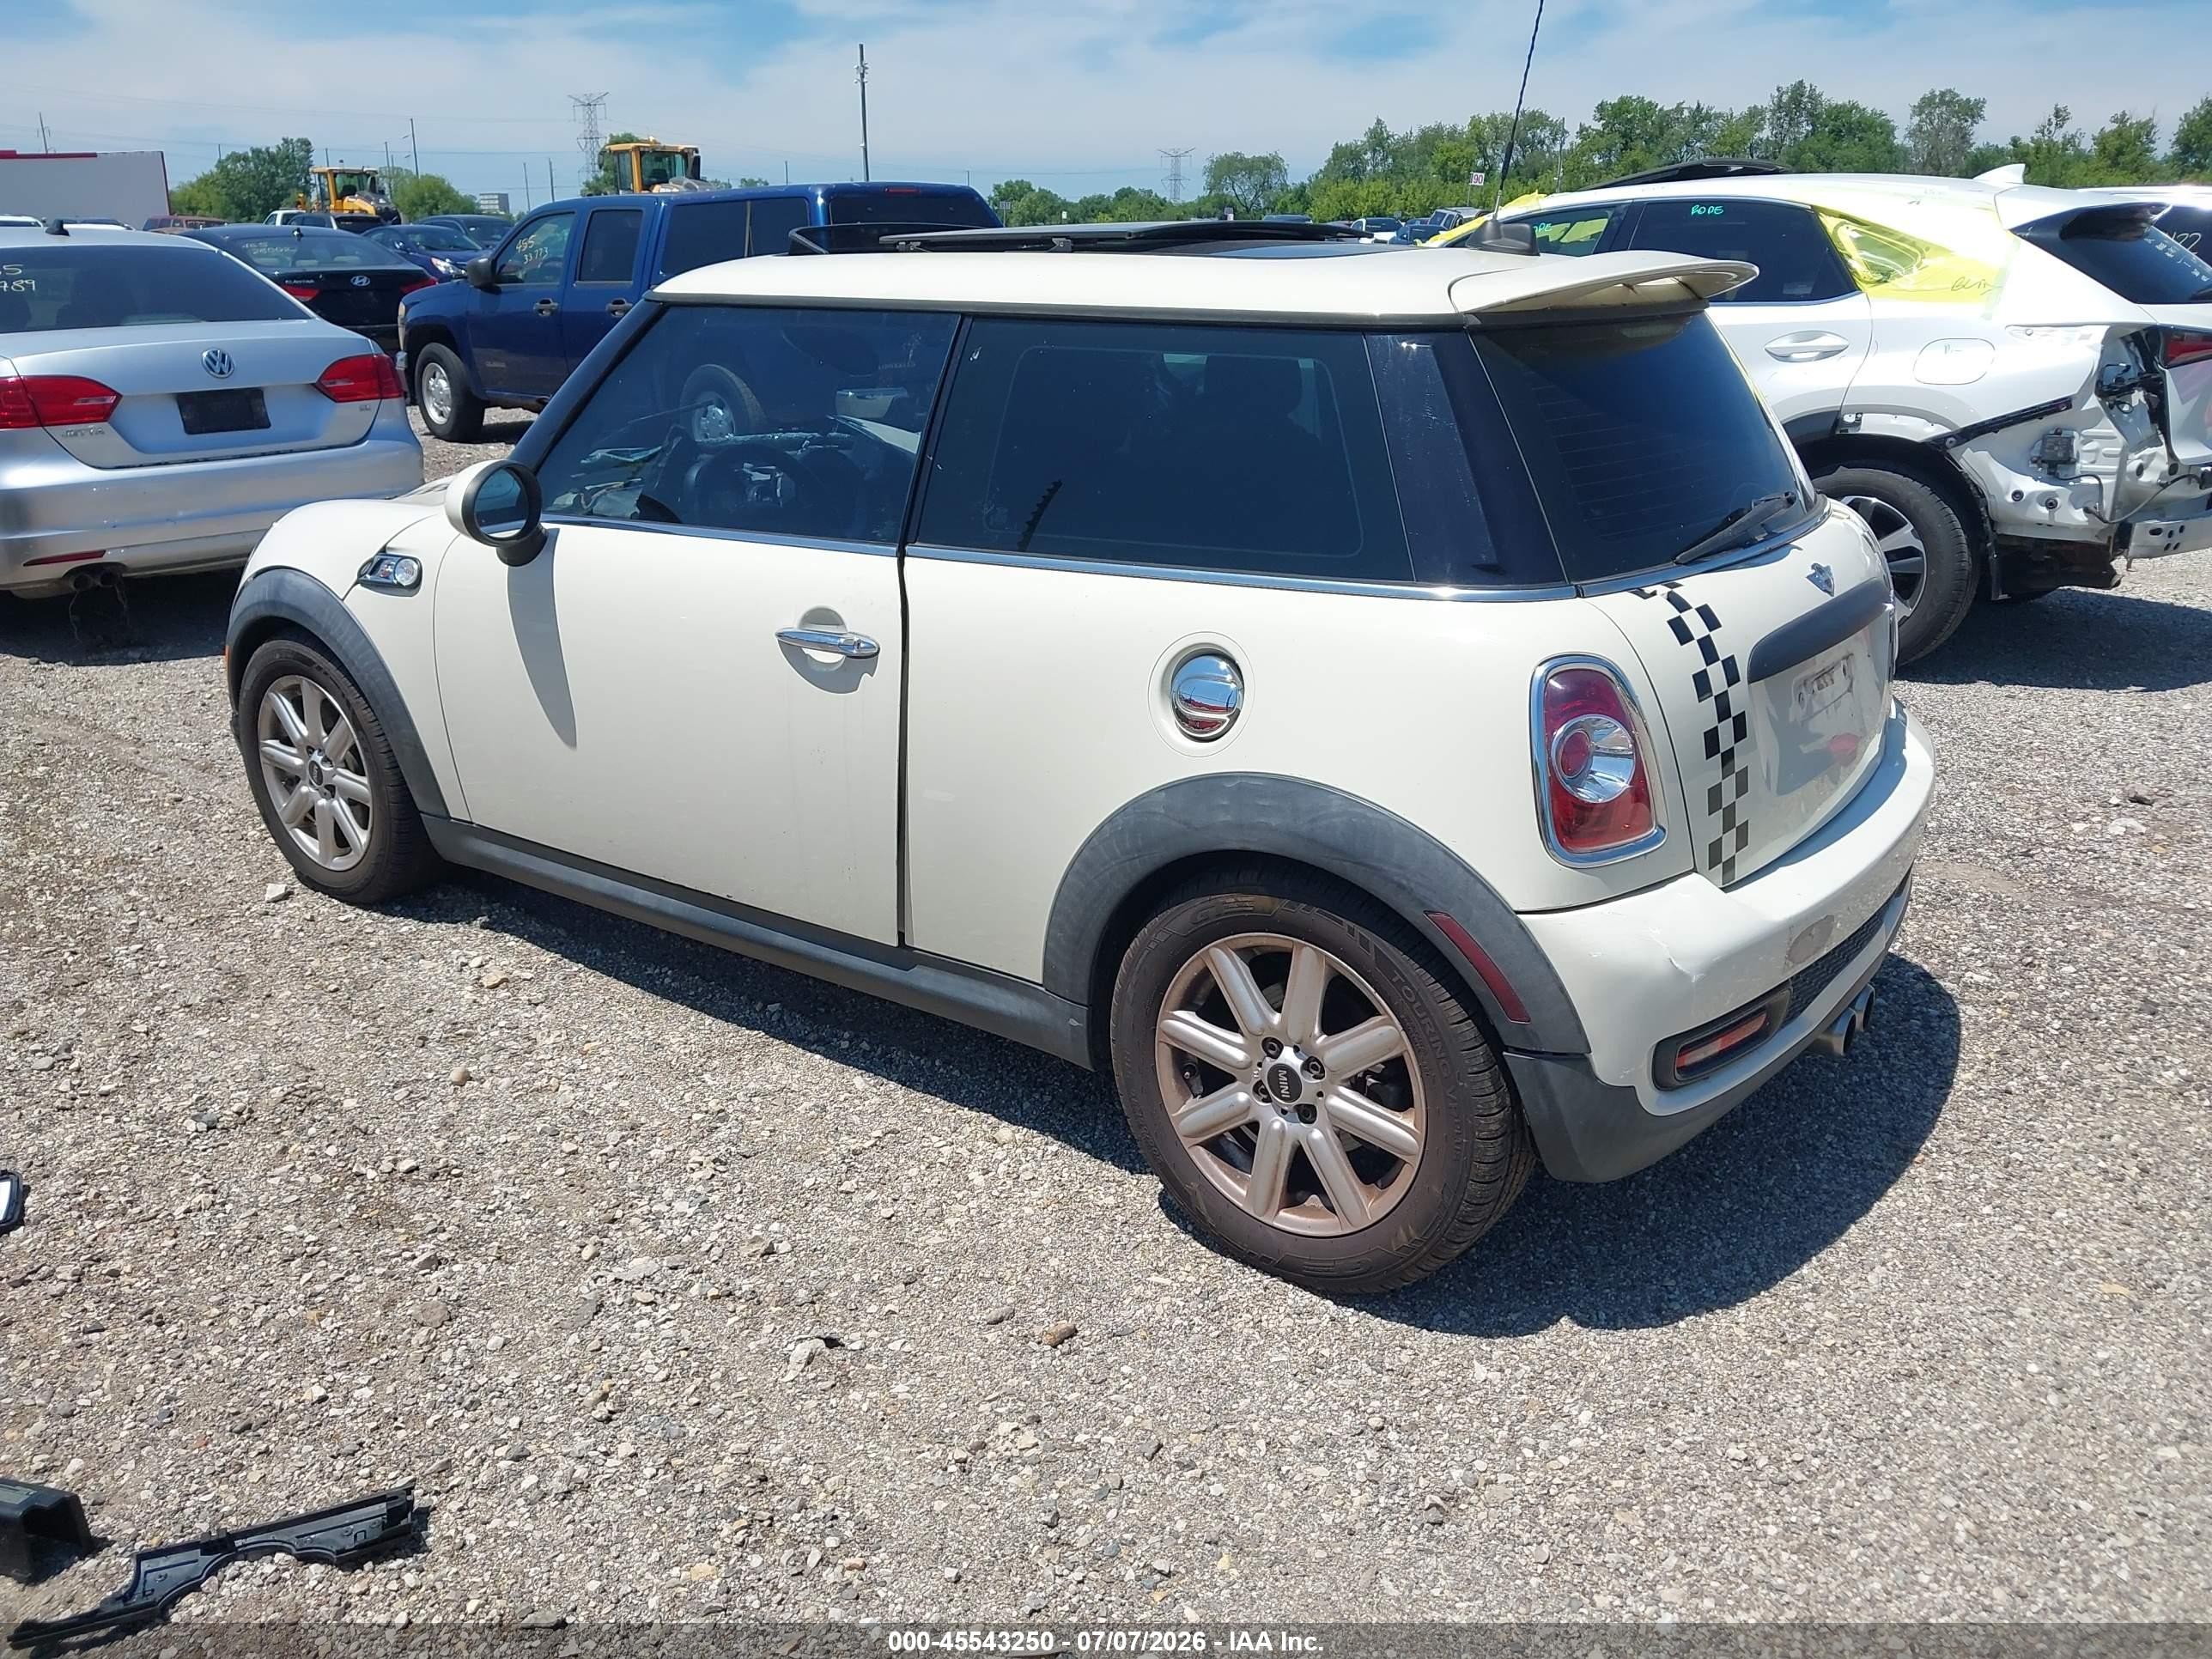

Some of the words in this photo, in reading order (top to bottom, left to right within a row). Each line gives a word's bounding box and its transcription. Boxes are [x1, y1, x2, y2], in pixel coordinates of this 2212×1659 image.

[0, 264, 24, 276] 5
[1391, 969, 1451, 1079] TOURING
[1278, 1069, 1291, 1098] MINI
